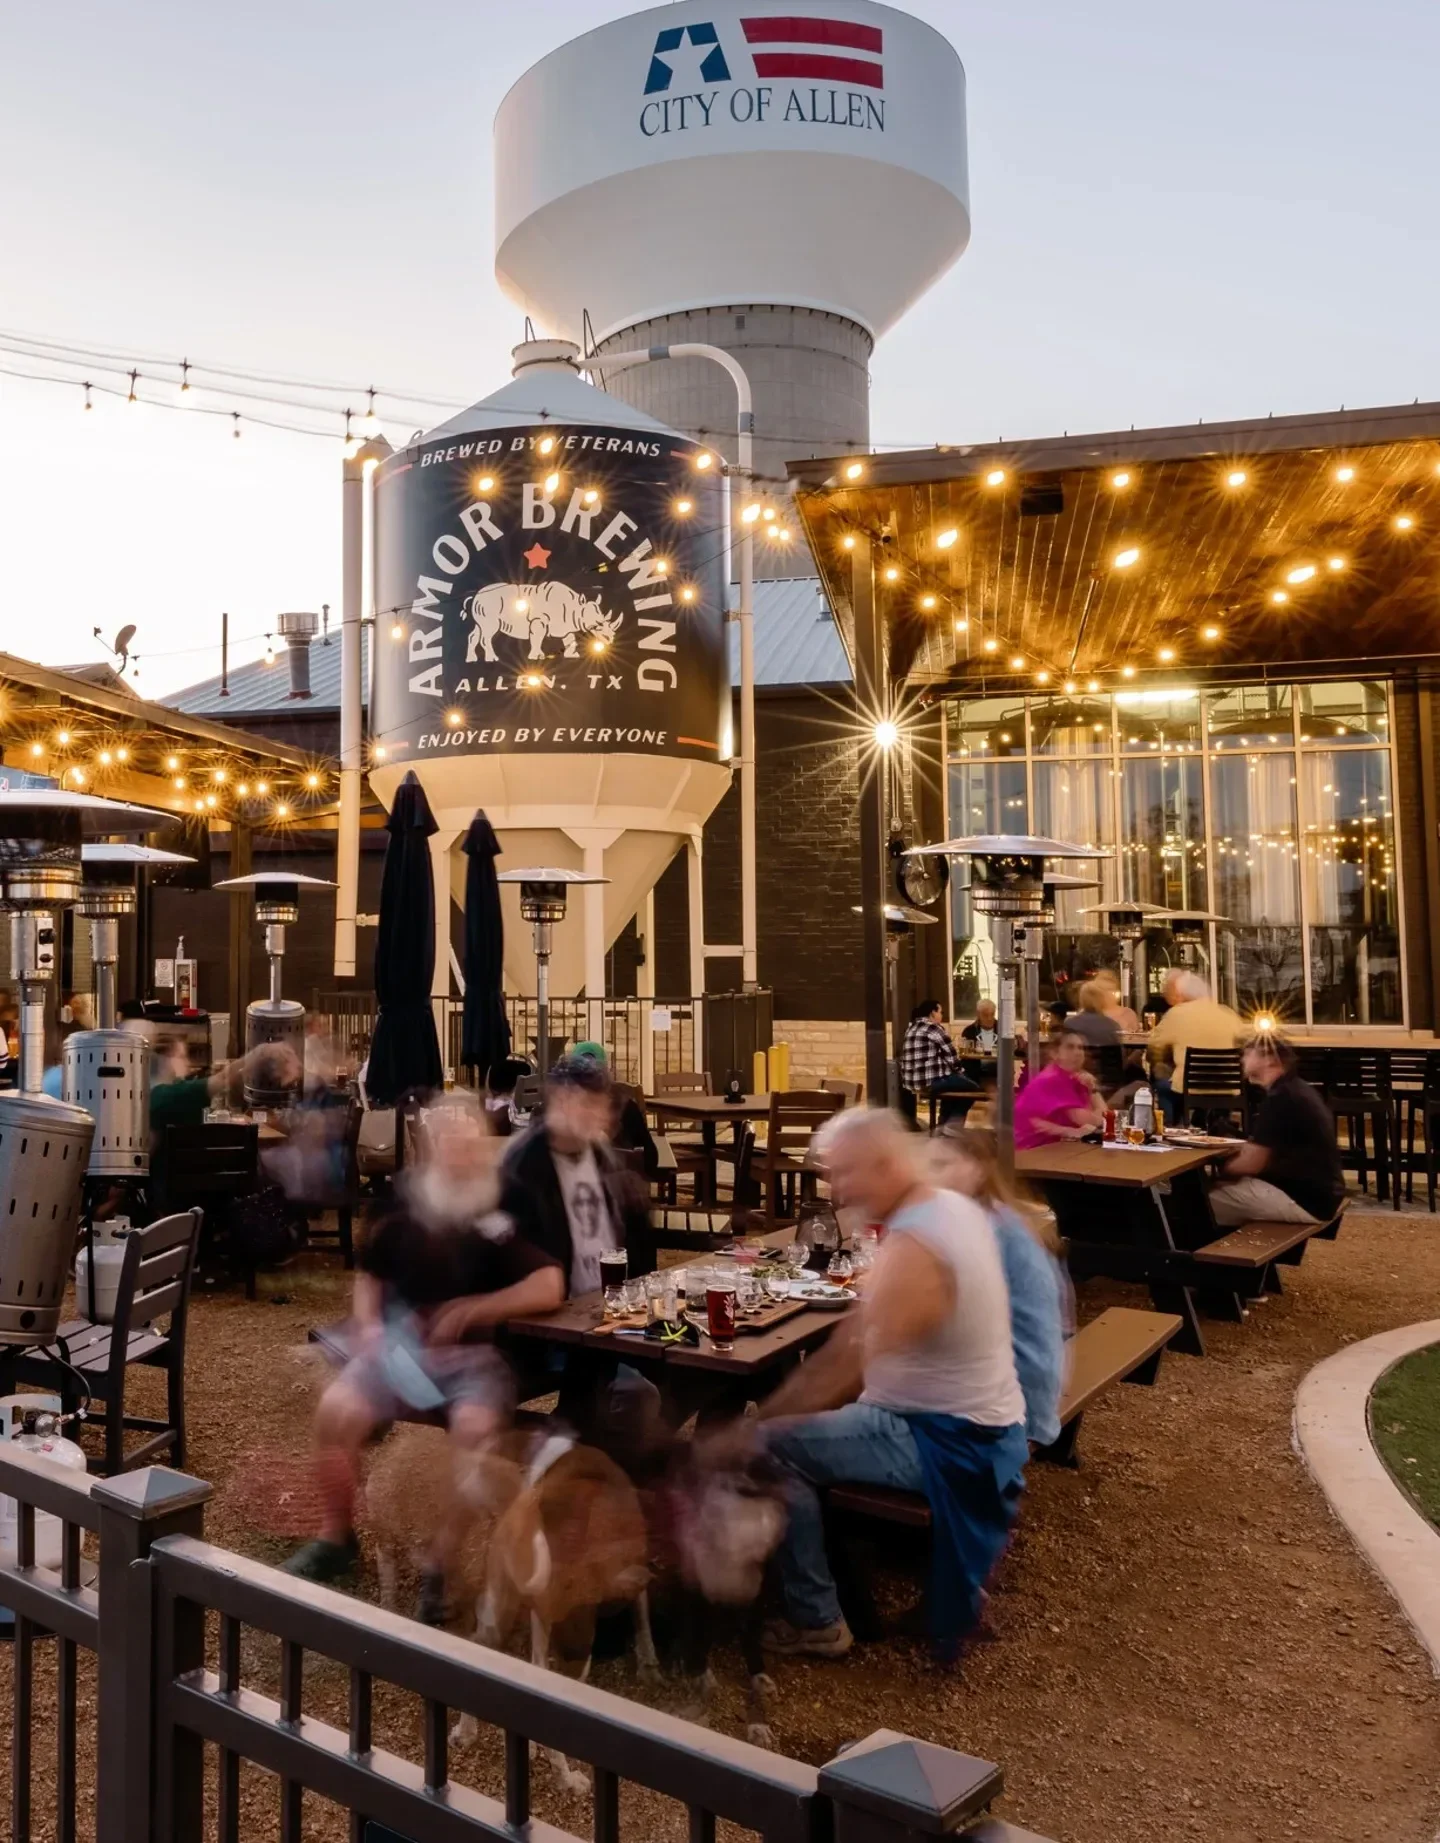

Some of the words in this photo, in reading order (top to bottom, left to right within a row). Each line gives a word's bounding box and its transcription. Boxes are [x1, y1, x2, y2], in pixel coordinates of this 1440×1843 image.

[640, 91, 719, 136] CITY
[730, 87, 772, 123] OF
[783, 88, 886, 132] ALLEN
[420, 439, 502, 468] BREWED
[510, 436, 541, 451] BY
[409, 502, 504, 697] ARMOR
[522, 482, 677, 692] BREWING
[587, 675, 623, 690] TX
[418, 729, 507, 749] ENJOYED
[515, 728, 545, 742] BY
[552, 728, 667, 745] EVERYONE
